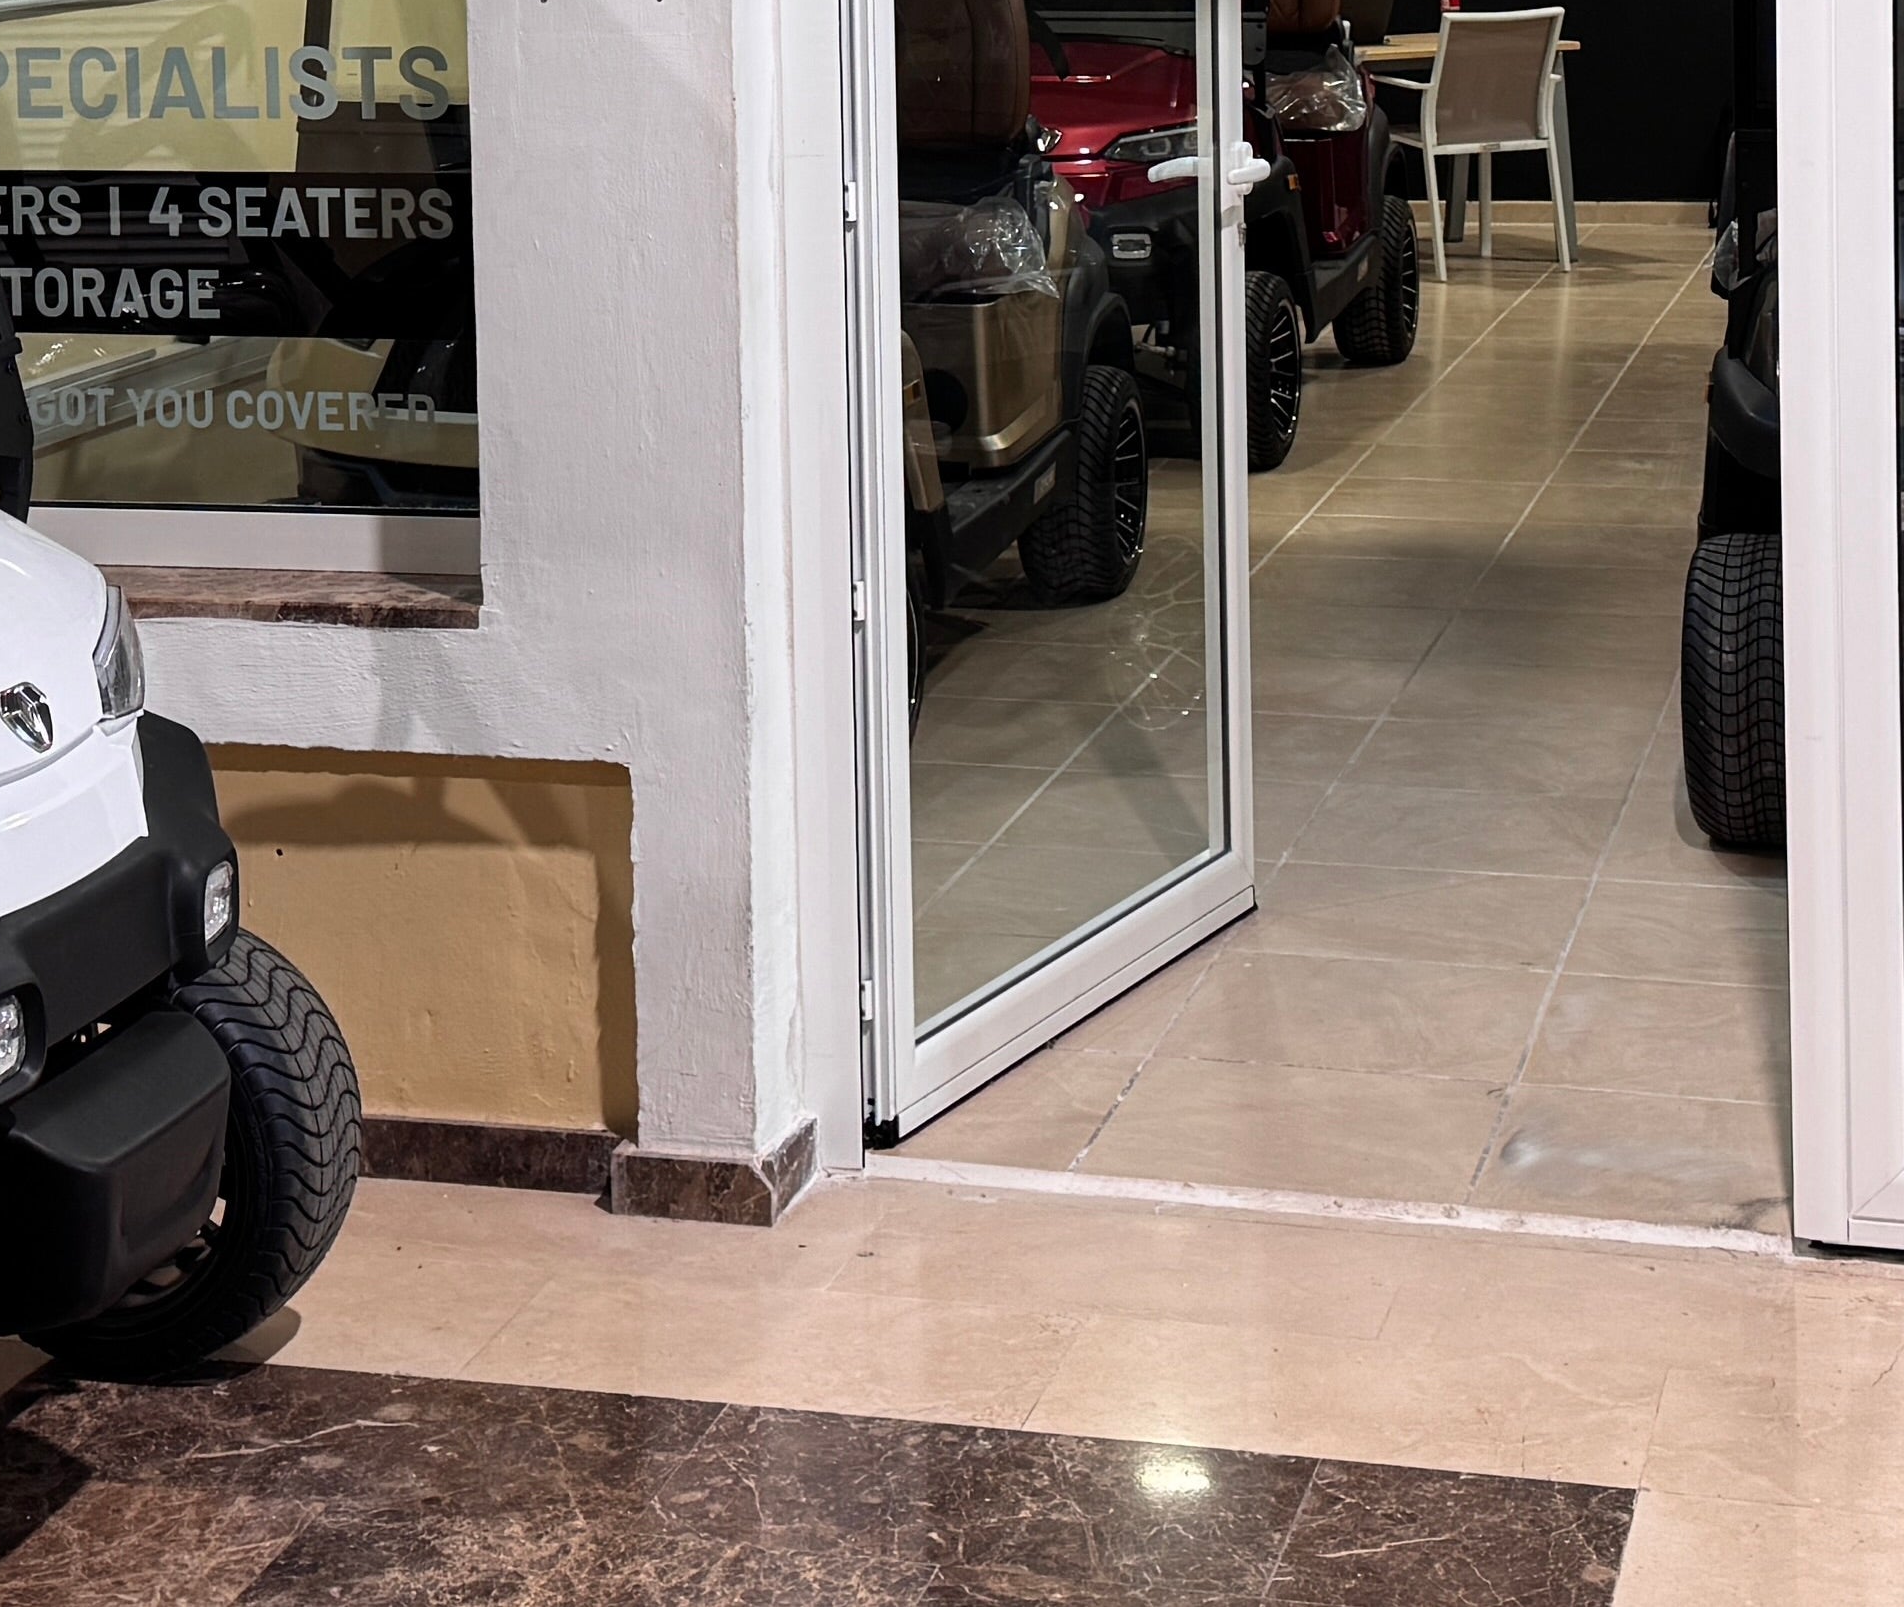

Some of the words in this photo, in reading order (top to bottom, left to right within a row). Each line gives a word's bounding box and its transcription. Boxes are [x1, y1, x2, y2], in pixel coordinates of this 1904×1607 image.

[150, 186, 184, 237] 4
[199, 185, 454, 238] SEATERS
[0, 267, 221, 320] TORAGE
[30, 388, 114, 428] GOT
[127, 388, 214, 429] YOU
[227, 390, 435, 432] COVERED
